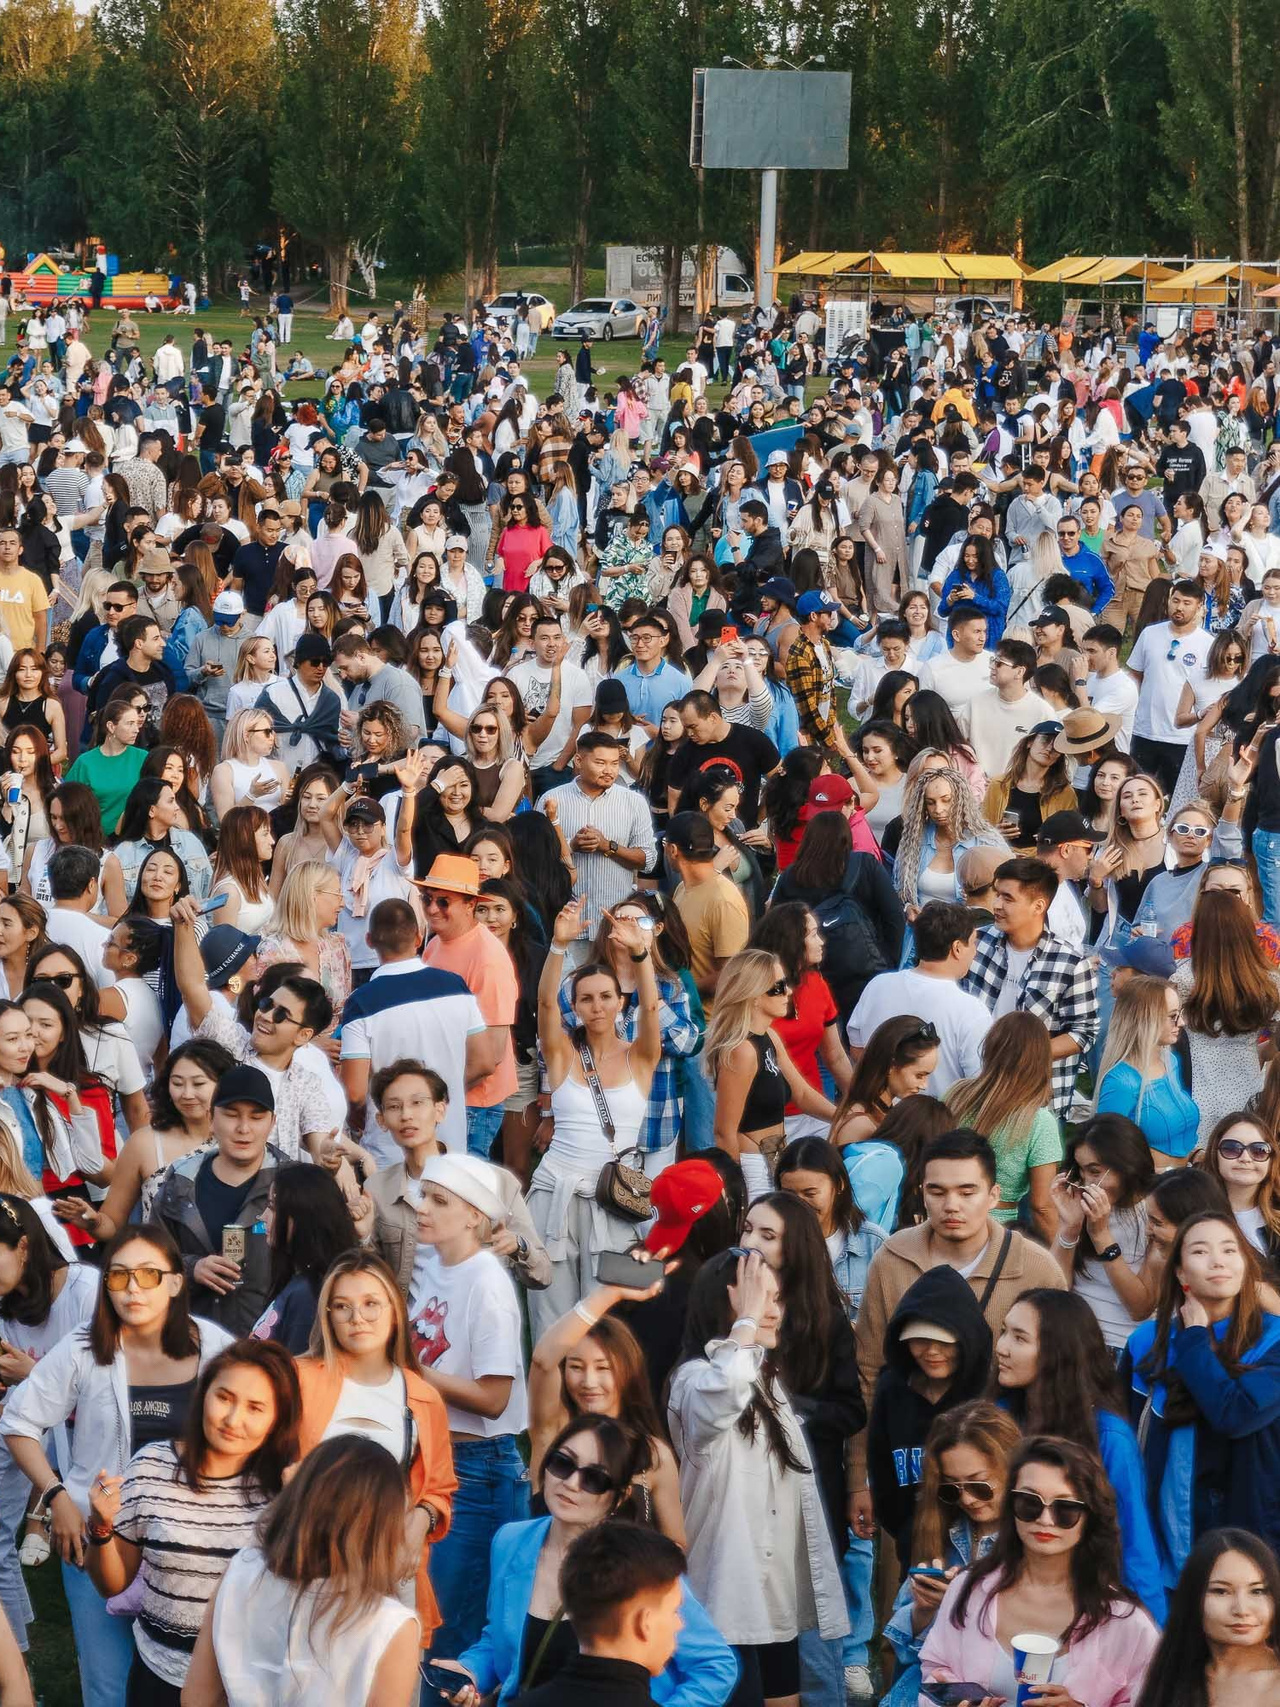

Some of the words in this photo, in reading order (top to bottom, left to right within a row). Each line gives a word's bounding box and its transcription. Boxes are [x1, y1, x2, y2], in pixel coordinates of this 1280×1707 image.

[222, 942, 245, 967] EXCHANGE
[130, 1401, 142, 1412] LOS
[142, 1400, 170, 1414] ANGELES
[1019, 1671, 1037, 1681] Bull
